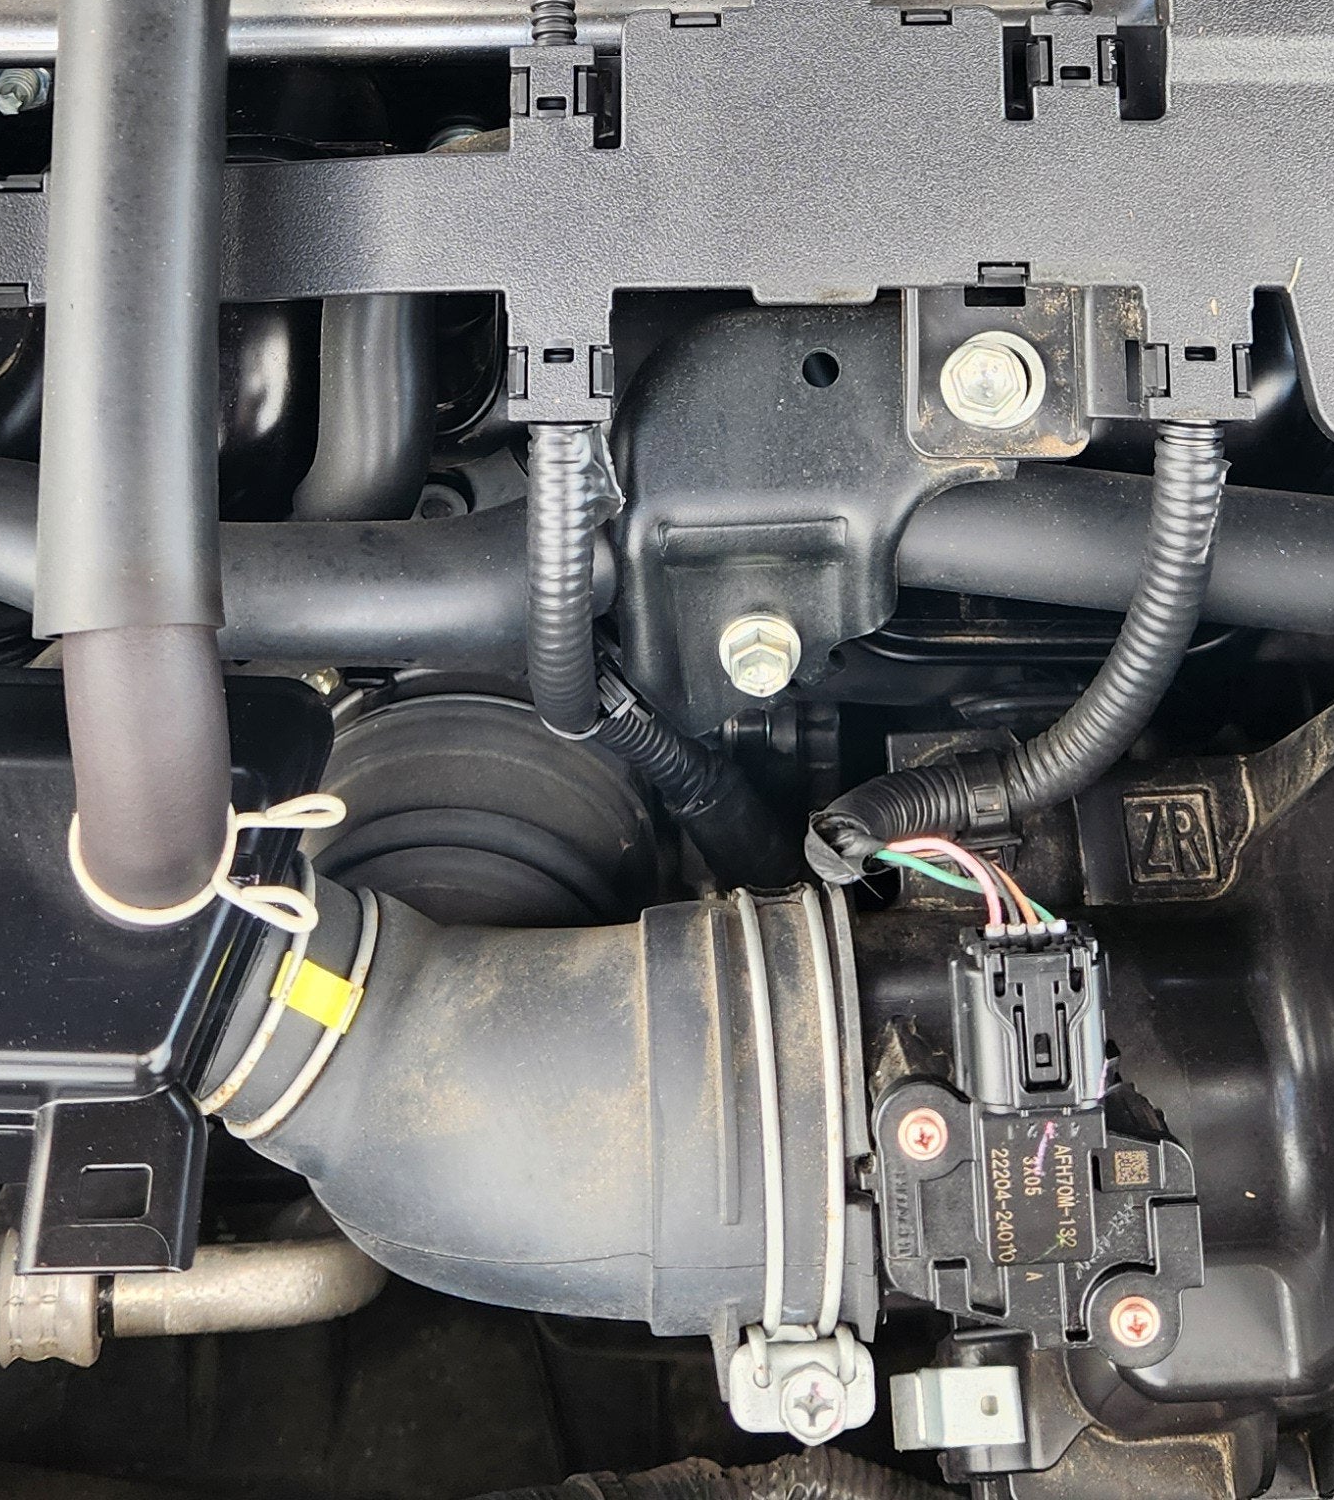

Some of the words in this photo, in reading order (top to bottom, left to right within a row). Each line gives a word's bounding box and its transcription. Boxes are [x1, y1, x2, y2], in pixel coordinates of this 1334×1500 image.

[1132, 801, 1211, 874] ZR
[990, 1147, 1018, 1264] 22204-24010
[1053, 1144, 1078, 1249] AFH70M-132
[1025, 1271, 1044, 1282] A
